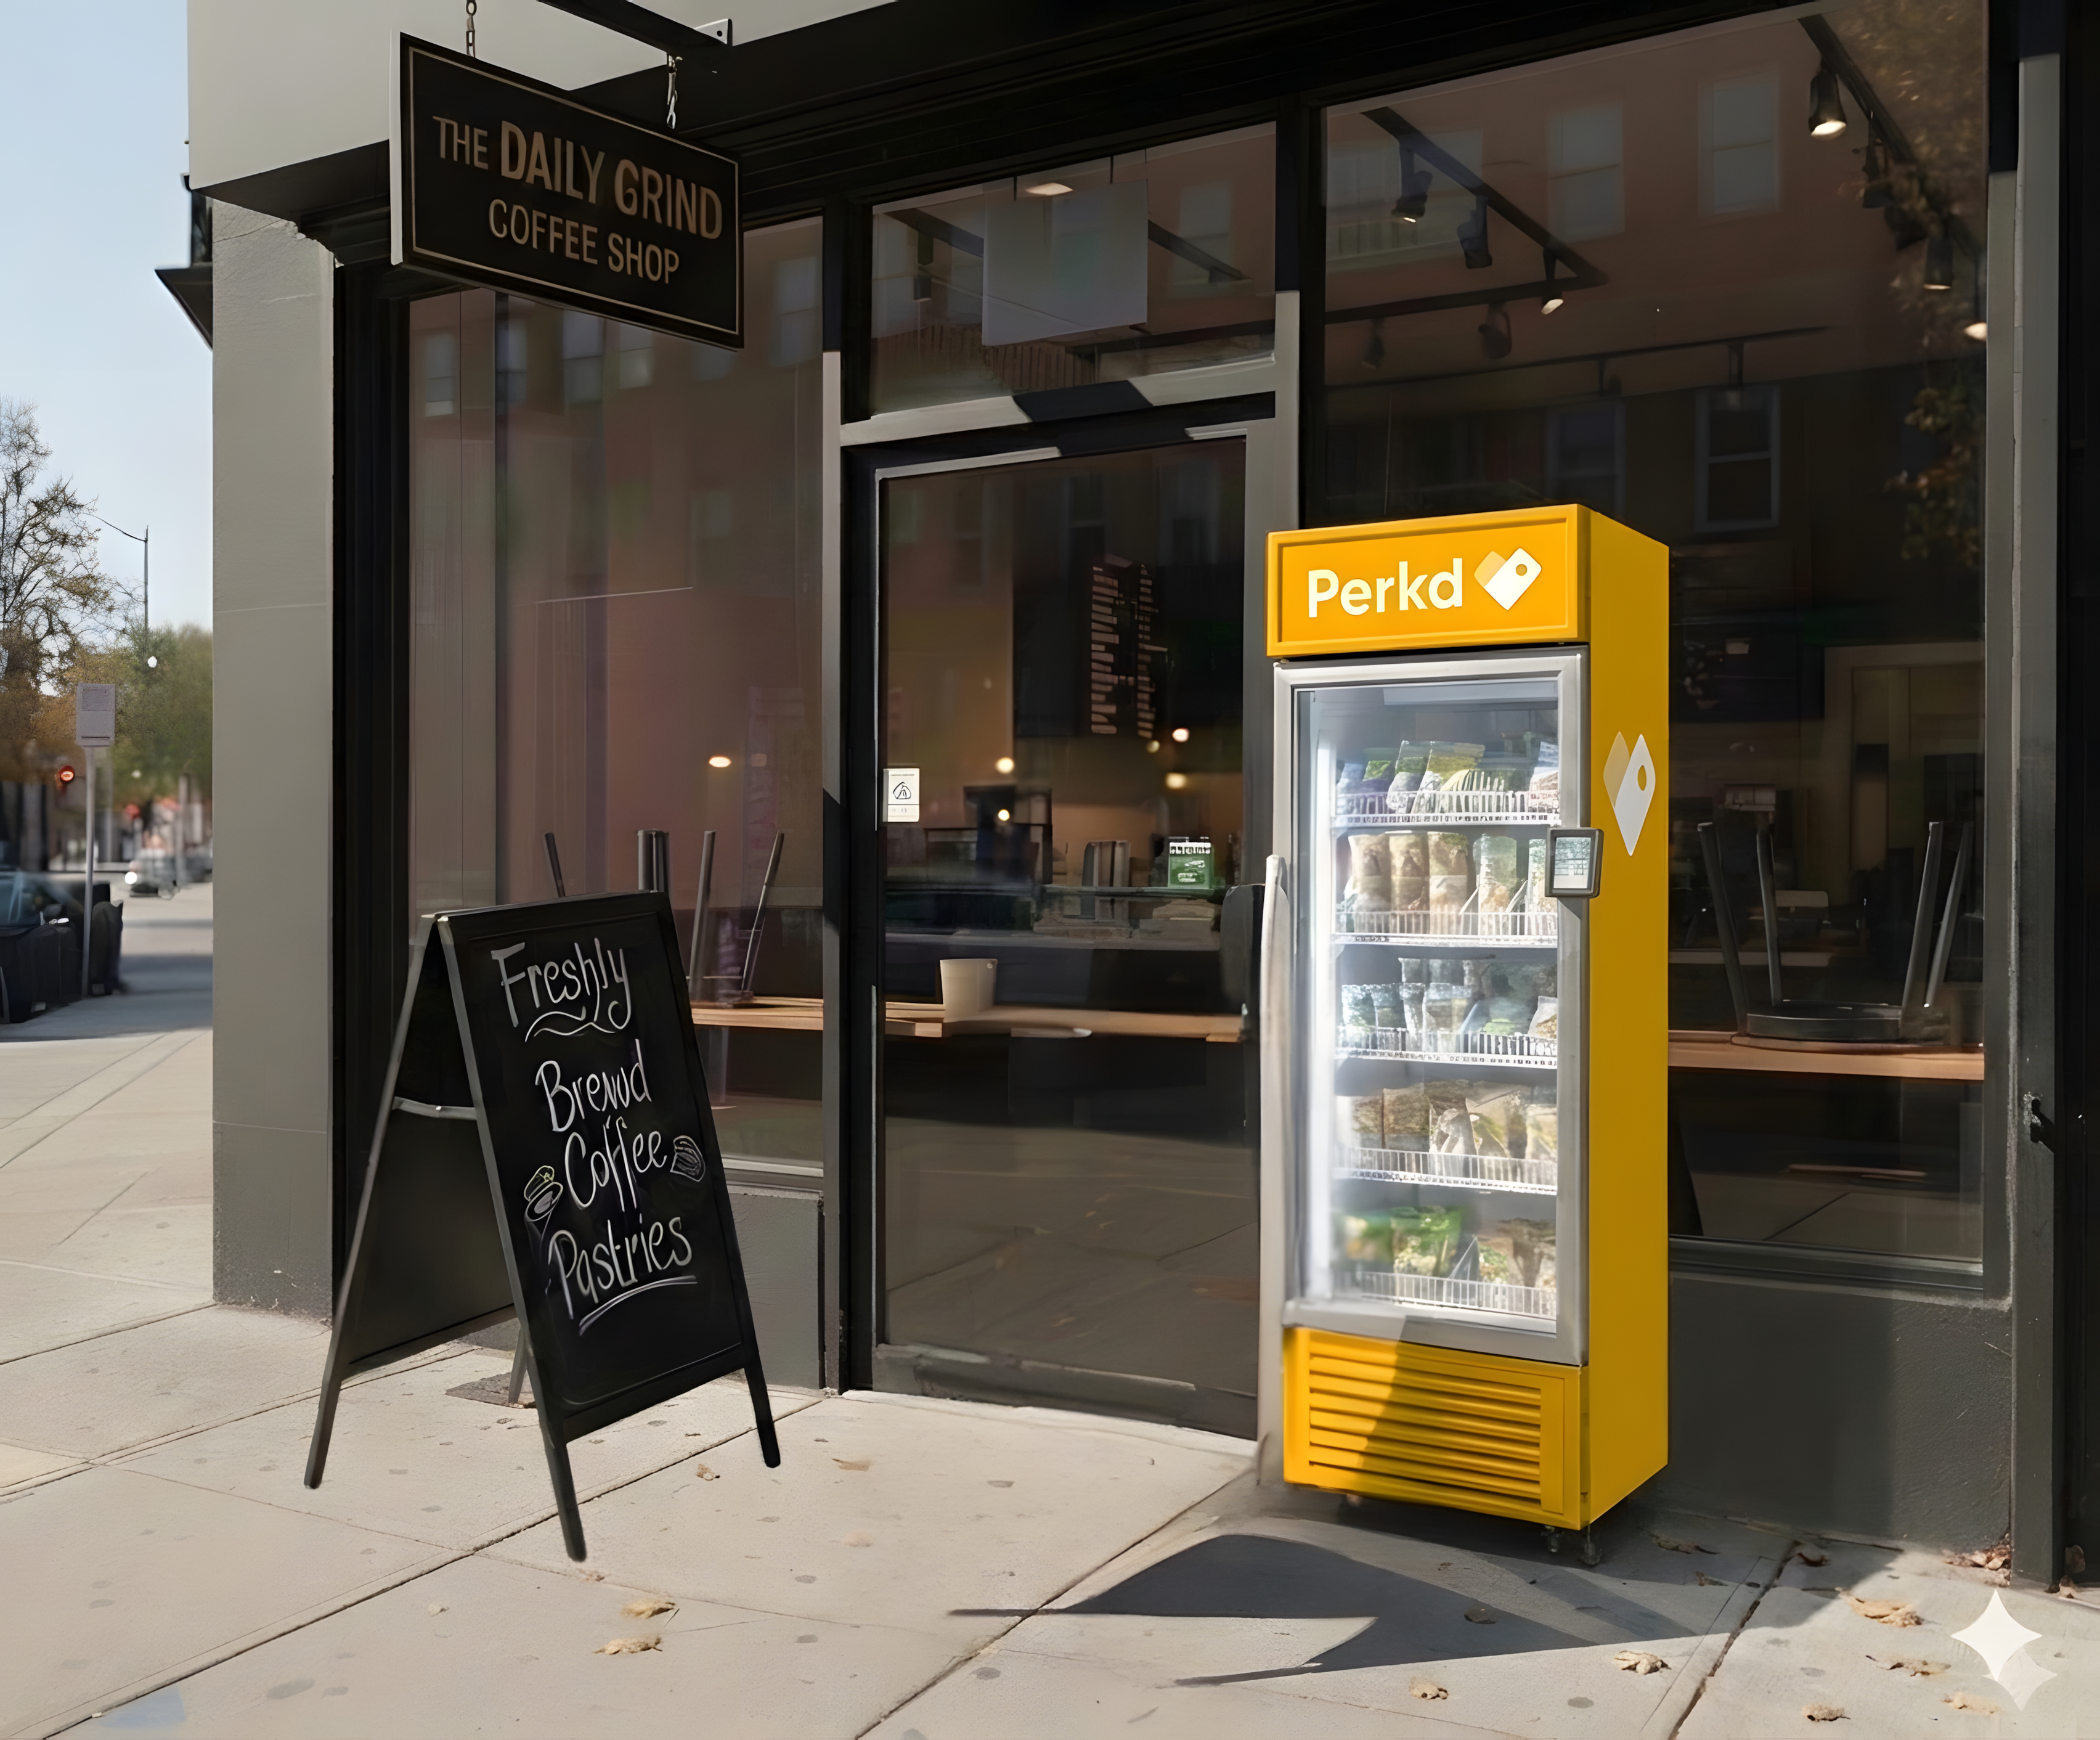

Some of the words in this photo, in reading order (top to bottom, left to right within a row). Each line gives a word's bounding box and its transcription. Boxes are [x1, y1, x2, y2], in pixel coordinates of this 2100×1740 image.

[433, 115, 489, 170] THE
[501, 120, 605, 205] DAILY
[614, 159, 723, 240] GRIND
[489, 199, 598, 264] COFFEE
[608, 232, 680, 284] SHOP
[1308, 558, 1463, 618] Perkd
[490, 937, 632, 1029] Freshly
[564, 1115, 667, 1212] Coffee
[548, 1214, 692, 1320] Pastries
